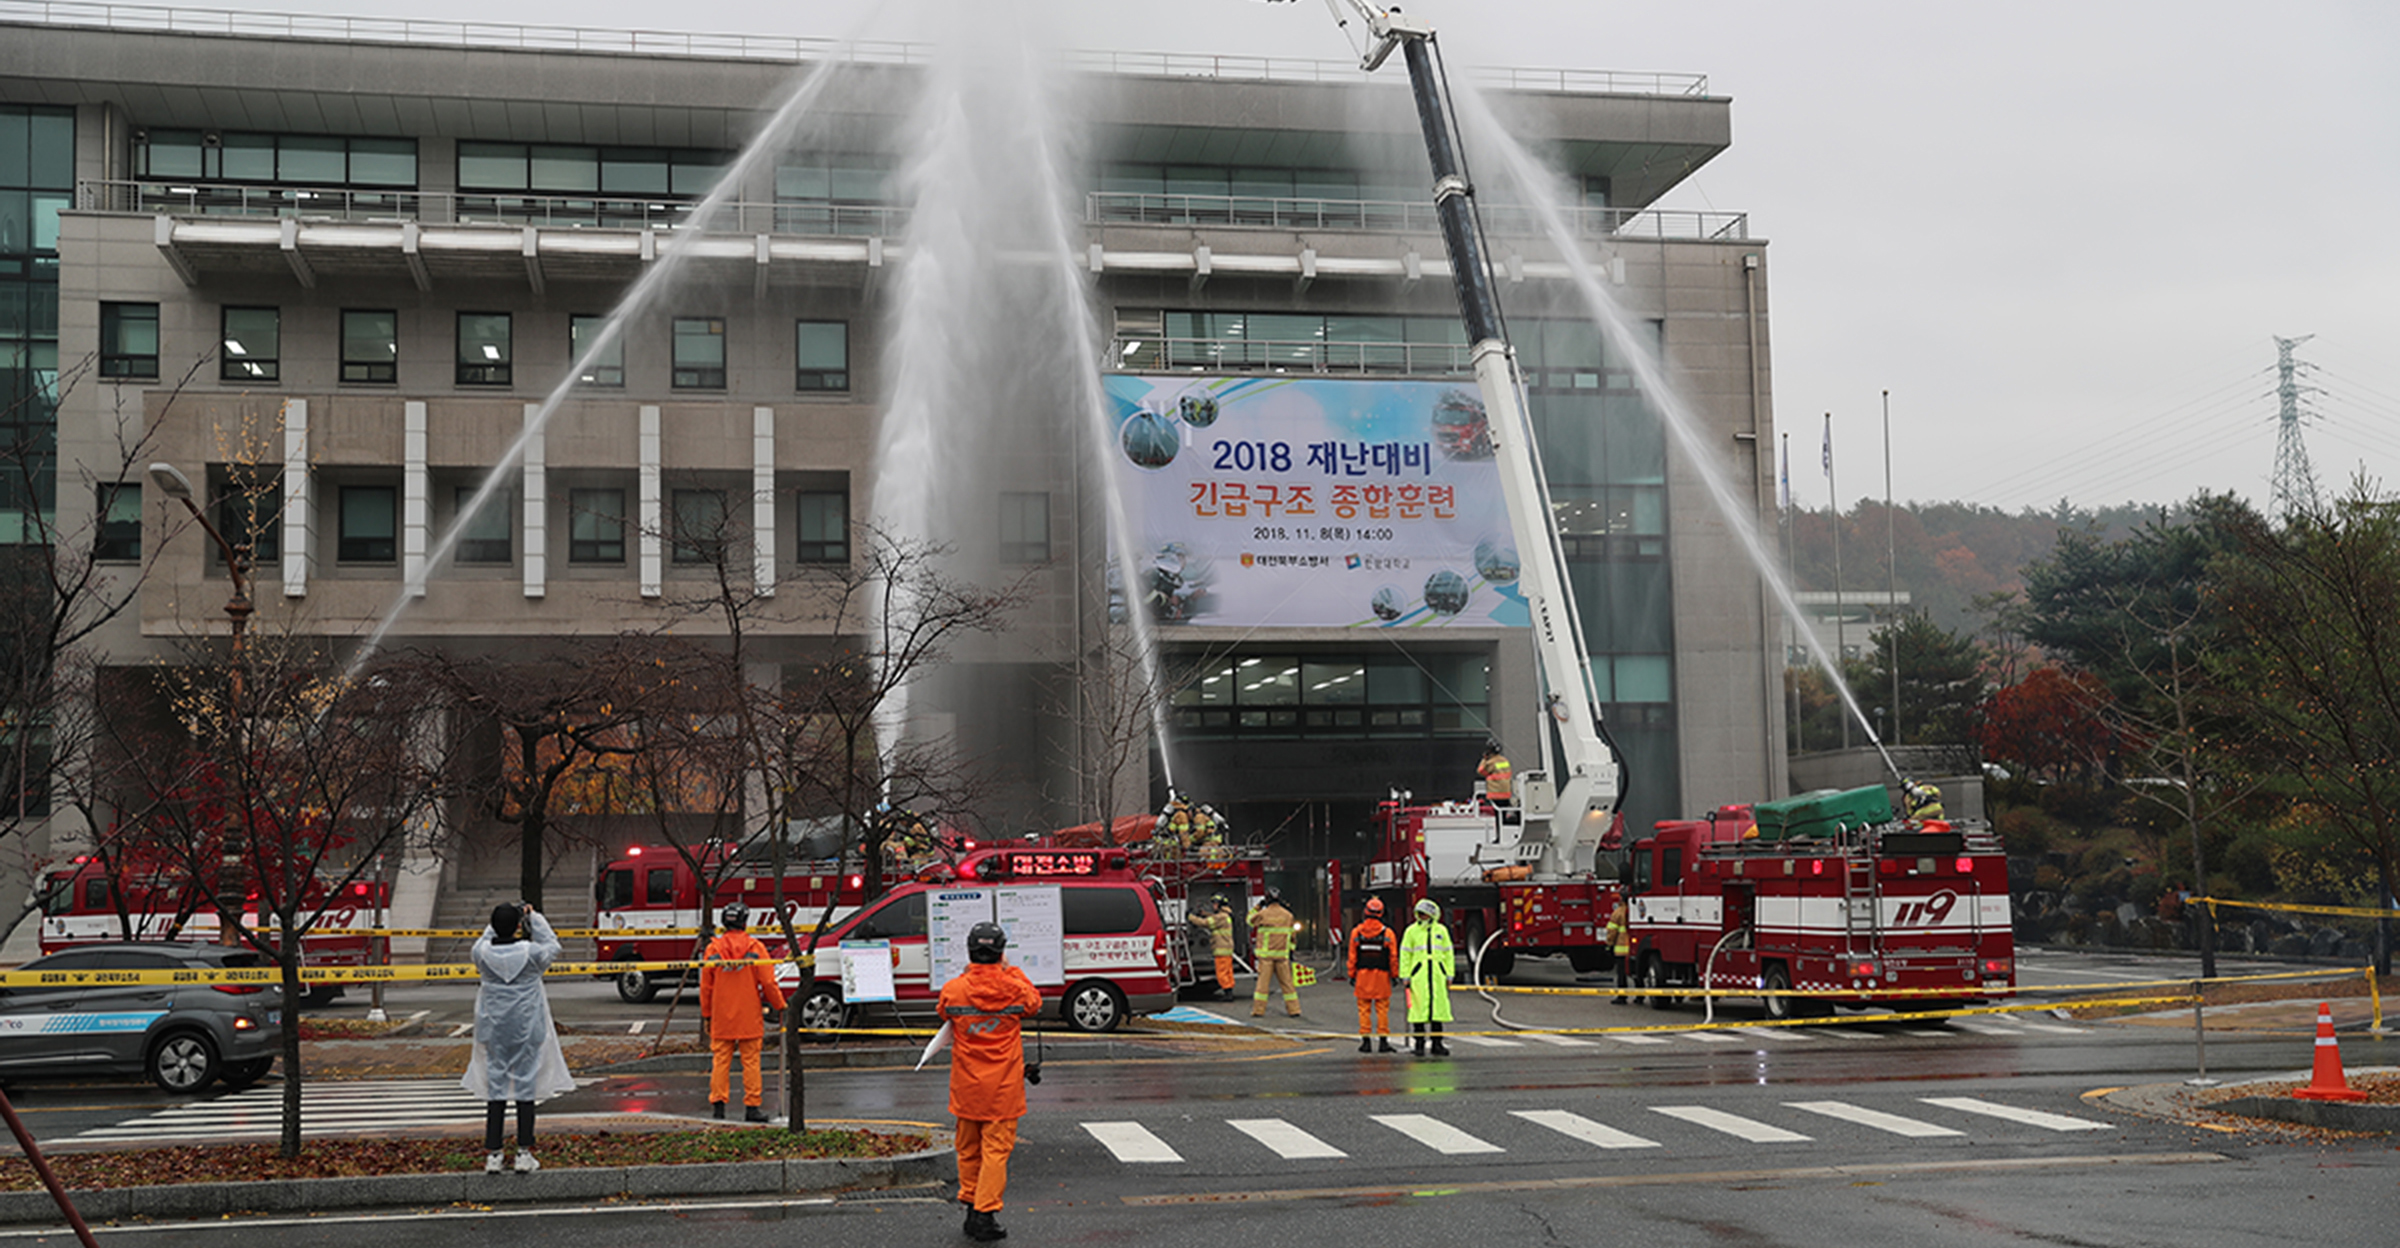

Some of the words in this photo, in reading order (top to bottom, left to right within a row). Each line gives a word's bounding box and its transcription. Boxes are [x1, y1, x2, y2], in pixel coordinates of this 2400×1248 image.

[1212, 440, 1293, 472] 2018
[1306, 441, 1431, 476] 재난대비
[1190, 481, 1316, 518] 긴급구조
[1330, 483, 1456, 519] 종합훈련
[1253, 527, 1290, 541] 2018.
[1296, 527, 1315, 541] 11.
[1320, 526, 1351, 541] 8(목)
[1356, 527, 1394, 541] 14:00
[1256, 554, 1330, 568] 대전북부소방서
[1012, 854, 1095, 875] 대전소방
[1892, 890, 1958, 927] 119
